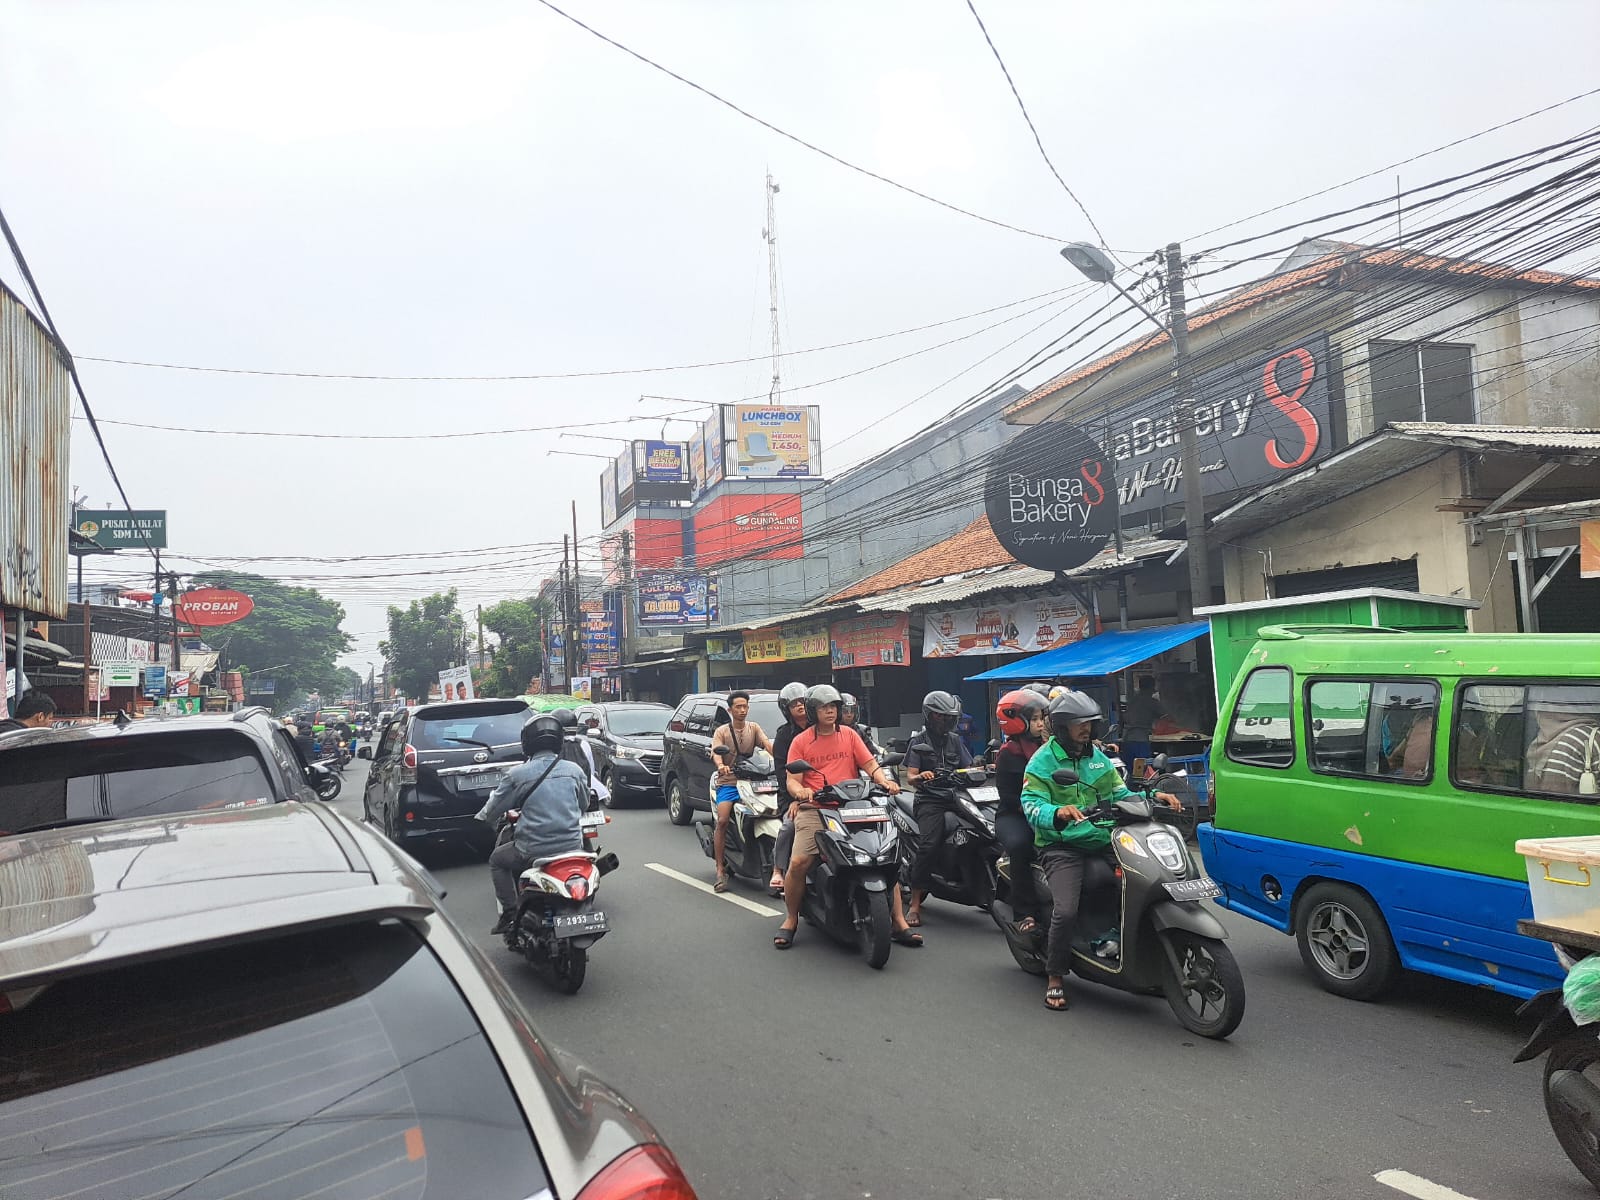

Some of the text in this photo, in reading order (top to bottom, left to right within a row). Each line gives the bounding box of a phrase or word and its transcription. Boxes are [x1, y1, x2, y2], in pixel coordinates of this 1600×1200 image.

[741, 411, 802, 422] LUNCHBOX
[652, 449, 676, 457] FREE
[1008, 473, 1083, 503] Bunga
[1009, 497, 1092, 527] Bakery
[101, 519, 128, 529] PUSAT
[750, 516, 799, 525] GUNDALING
[112, 529, 131, 539] SDM
[183, 601, 239, 612] PROBAN
